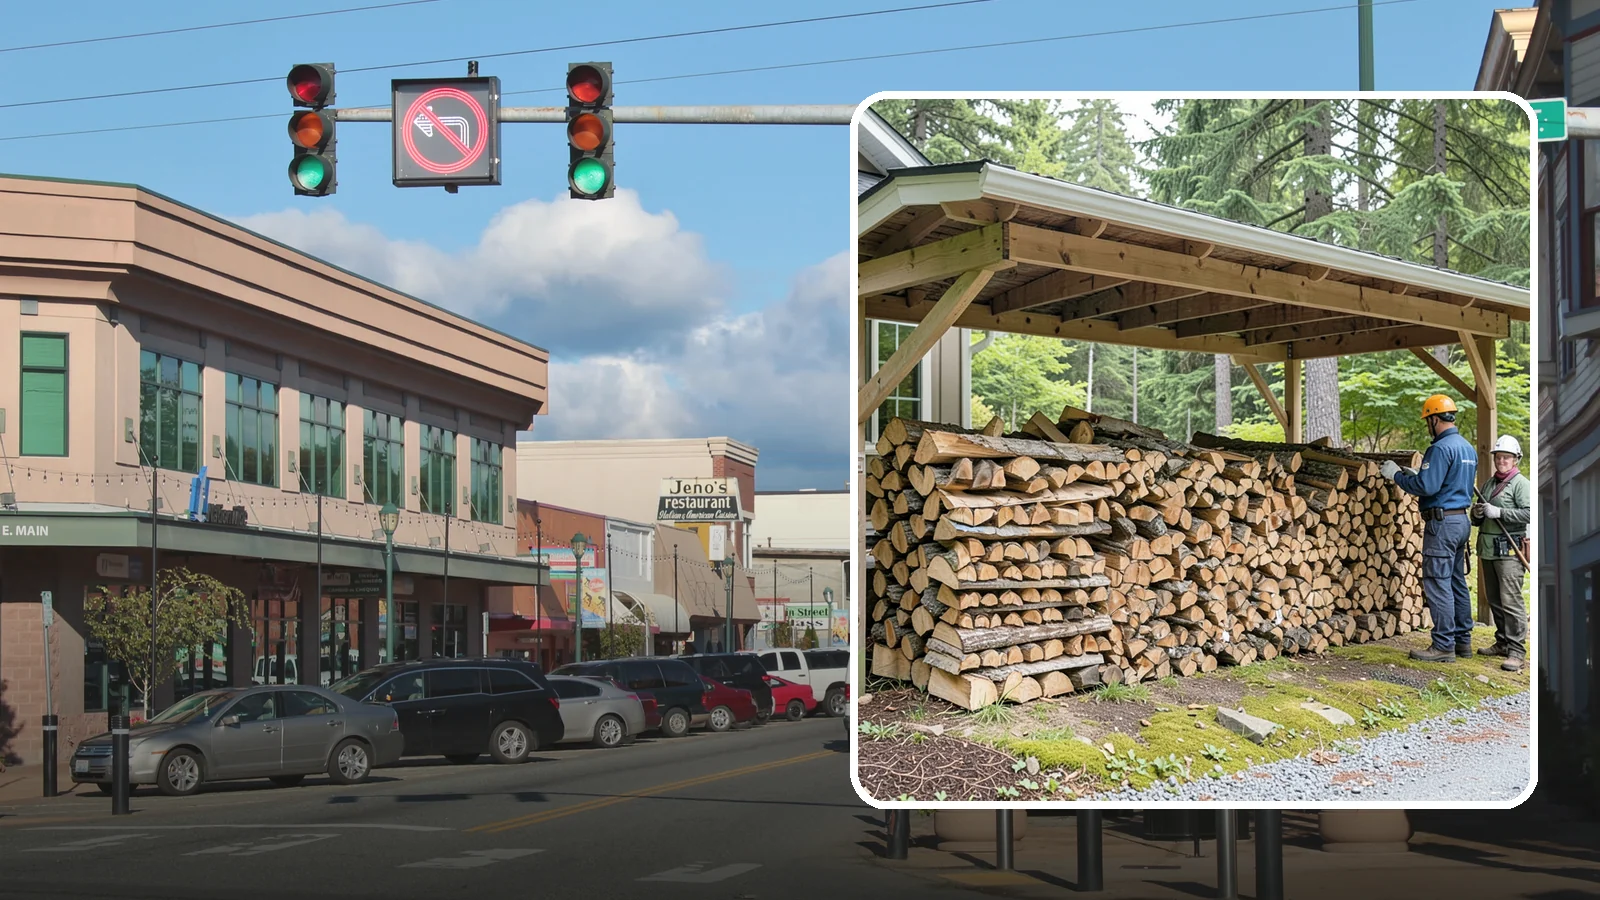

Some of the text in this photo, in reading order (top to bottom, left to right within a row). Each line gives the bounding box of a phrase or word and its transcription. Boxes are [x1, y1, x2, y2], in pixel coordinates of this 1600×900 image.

[670, 480, 727, 494] Jeno's
[665, 496, 731, 509] restaurant
[715, 509, 737, 519] Cuisine
[2, 525, 49, 536] E. MAIN
[798, 608, 828, 616] Street
